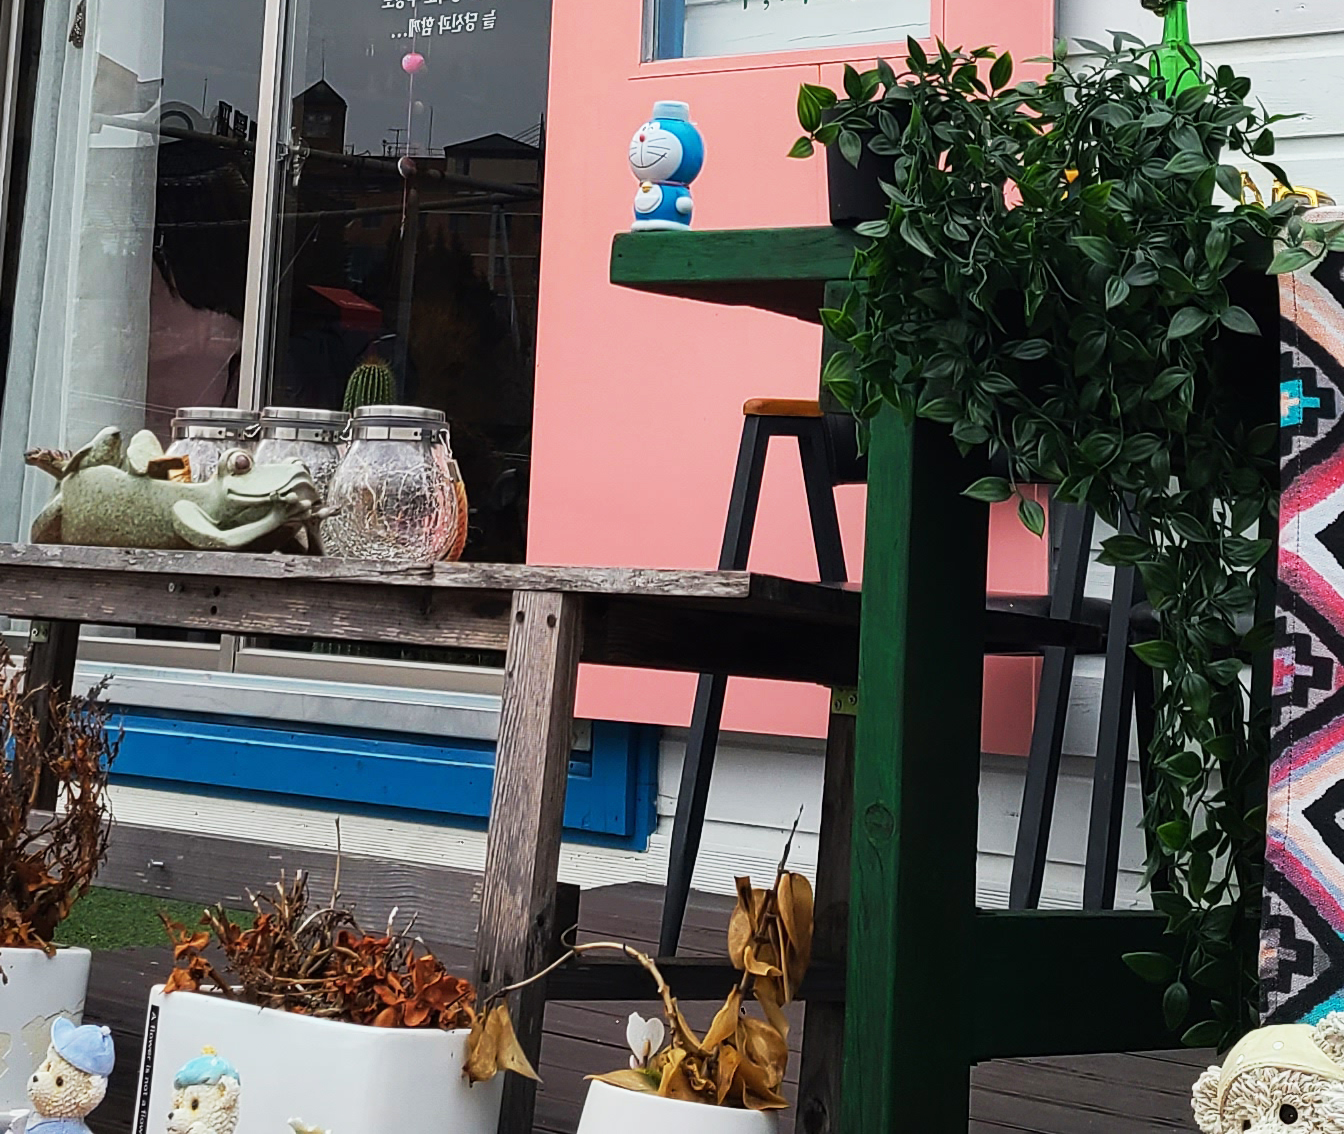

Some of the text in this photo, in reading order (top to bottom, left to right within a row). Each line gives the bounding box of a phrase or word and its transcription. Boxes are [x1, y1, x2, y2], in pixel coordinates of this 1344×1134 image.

[150, 1011, 157, 1021] A
[146, 1025, 156, 1061] flower
[144, 1065, 152, 1074] is
[142, 1077, 150, 1096] not
[141, 1099, 147, 1107] a
